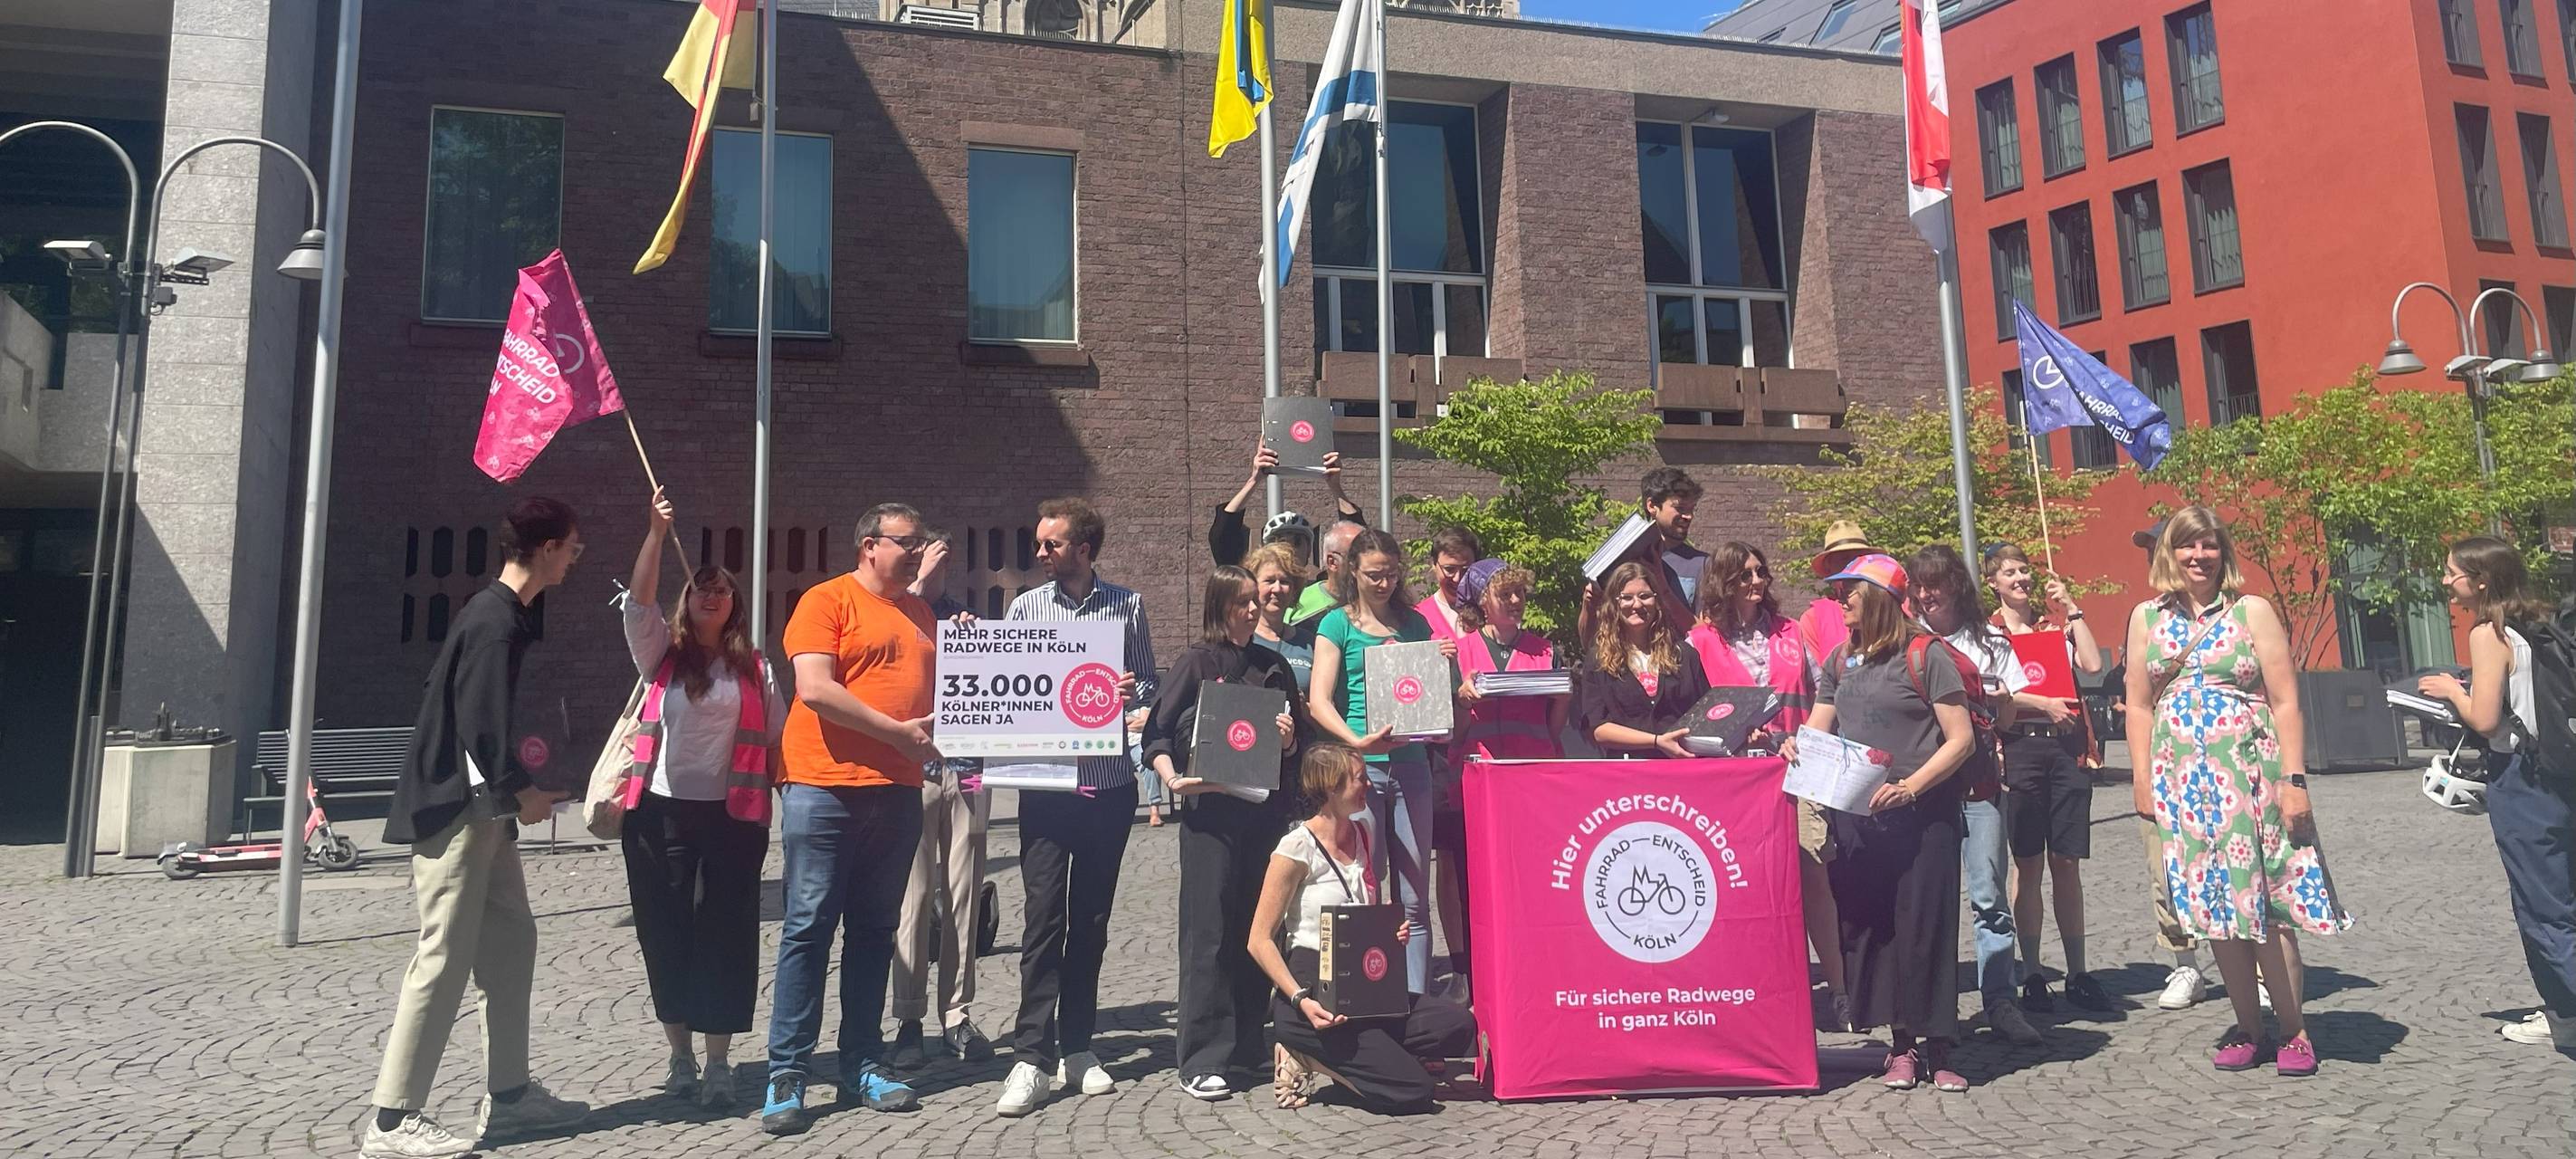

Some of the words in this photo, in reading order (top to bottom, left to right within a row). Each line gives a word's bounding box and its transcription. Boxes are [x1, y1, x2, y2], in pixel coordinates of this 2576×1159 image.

[944, 628, 988, 640] MEHR
[992, 628, 1057, 640] SICHERE
[944, 642, 1023, 653] RADWEGE
[1027, 642, 1042, 653] IN
[942, 674, 1054, 697] 33.000
[1065, 670, 1086, 704] FAHRRAD
[940, 714, 991, 725] SAGEN
[996, 714, 1014, 725] JA
[1551, 834, 1581, 890] Hier
[1579, 793, 1749, 888] unterschreiben!
[1595, 839, 1631, 909] FAHRRAD
[1652, 834, 1706, 907] ENTSCHEID
[1633, 933, 1677, 950] KÖLN
[1556, 990, 1588, 1007] Für
[1592, 989, 1662, 1006] sichere
[1667, 987, 1756, 1005] Radwege
[1598, 1012, 1617, 1029] in
[1622, 1014, 1668, 1031] ganz
[1674, 1010, 1716, 1027] Köln
